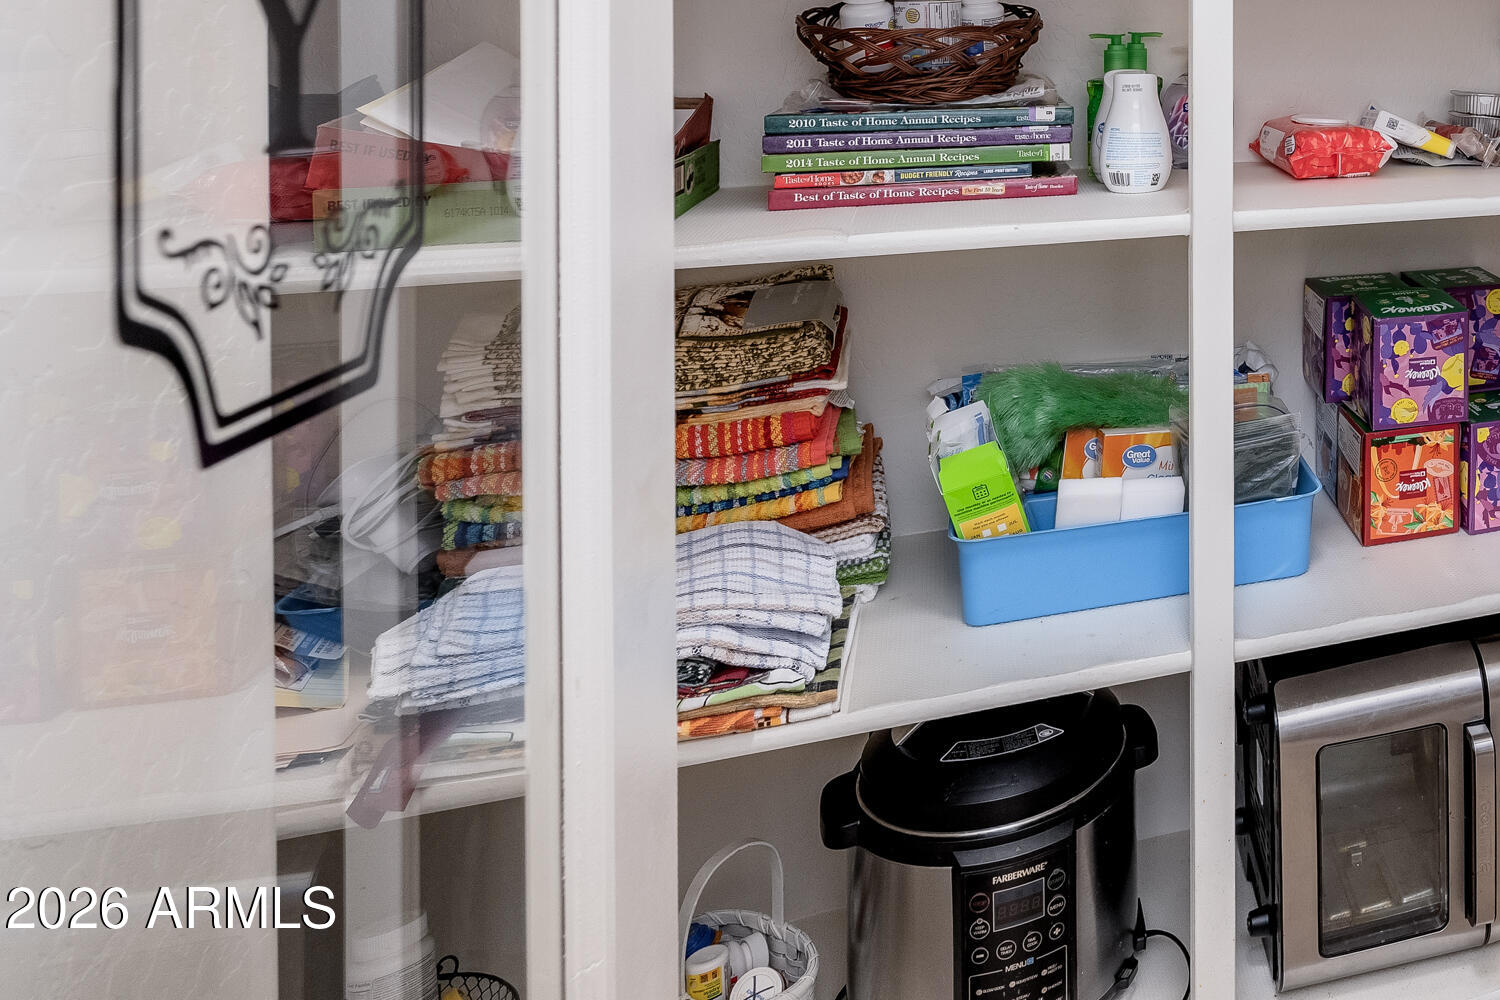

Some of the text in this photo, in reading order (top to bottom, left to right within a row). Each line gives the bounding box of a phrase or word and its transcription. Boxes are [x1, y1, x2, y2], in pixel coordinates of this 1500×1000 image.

[788, 114, 982, 128] 2010 Taste of Home Annual Recipes
[786, 133, 977, 149] 2011 Taste of Home Annual Recipes
[785, 152, 980, 169] 2014 Taste of Home Annual Recipes
[810, 174, 835, 183] Home
[925, 170, 953, 178] FRIENDLY
[954, 169, 979, 177] Recipes
[794, 187, 960, 202] Best of Taste of Home Recipes
[1380, 301, 1455, 314] Kleenex
[1404, 365, 1441, 380] Kleenex
[1126, 449, 1151, 459] Great
[1131, 456, 1151, 464] Value
[1395, 476, 1431, 492] Kleenex
[992, 861, 1046, 885] FARBERWARE
[1049, 901, 1065, 911] MENU
[1004, 961, 1027, 973] MENU
